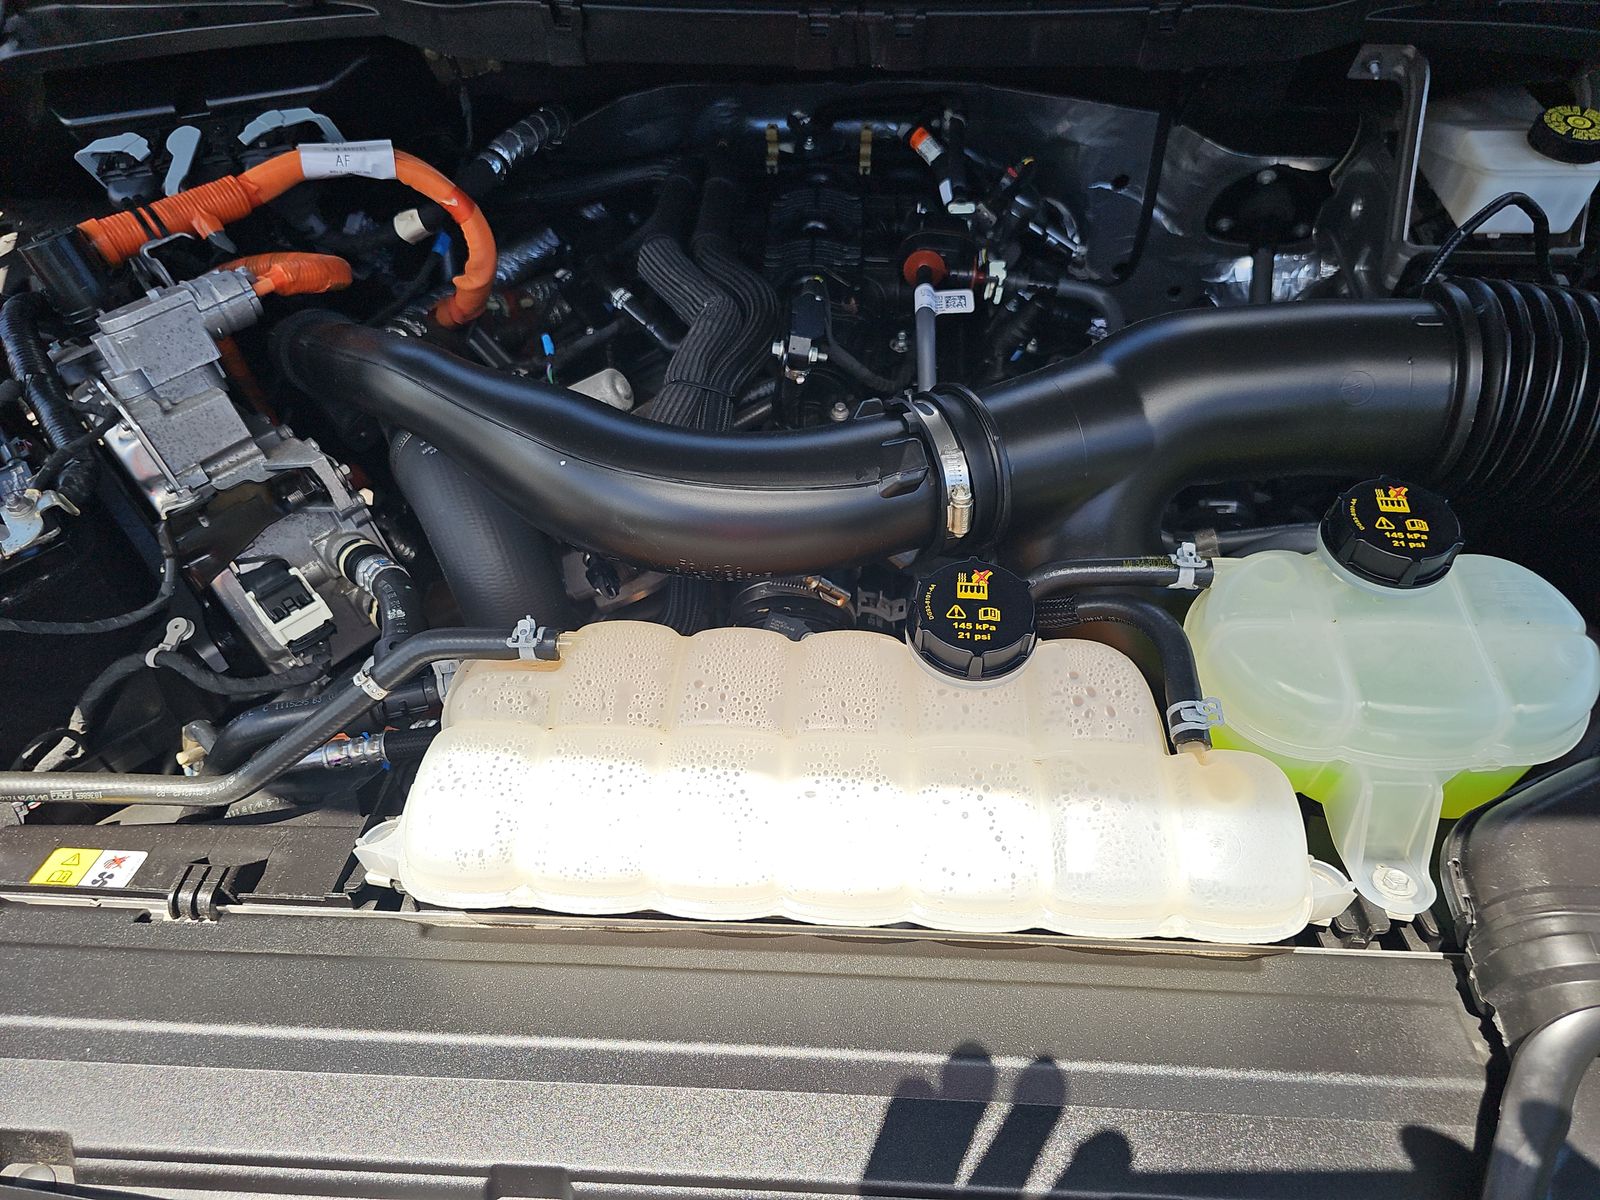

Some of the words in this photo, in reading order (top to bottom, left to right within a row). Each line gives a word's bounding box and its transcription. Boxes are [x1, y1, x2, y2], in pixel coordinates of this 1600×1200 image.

[336, 154, 351, 168] AF
[1384, 531, 1405, 540] 145
[1406, 532, 1429, 541] kPa
[1391, 540, 1406, 548] 21
[1408, 541, 1426, 549] psi
[952, 622, 974, 631] 145
[975, 623, 997, 631] kPa
[957, 631, 971, 640] 21
[974, 633, 991, 641] psi
